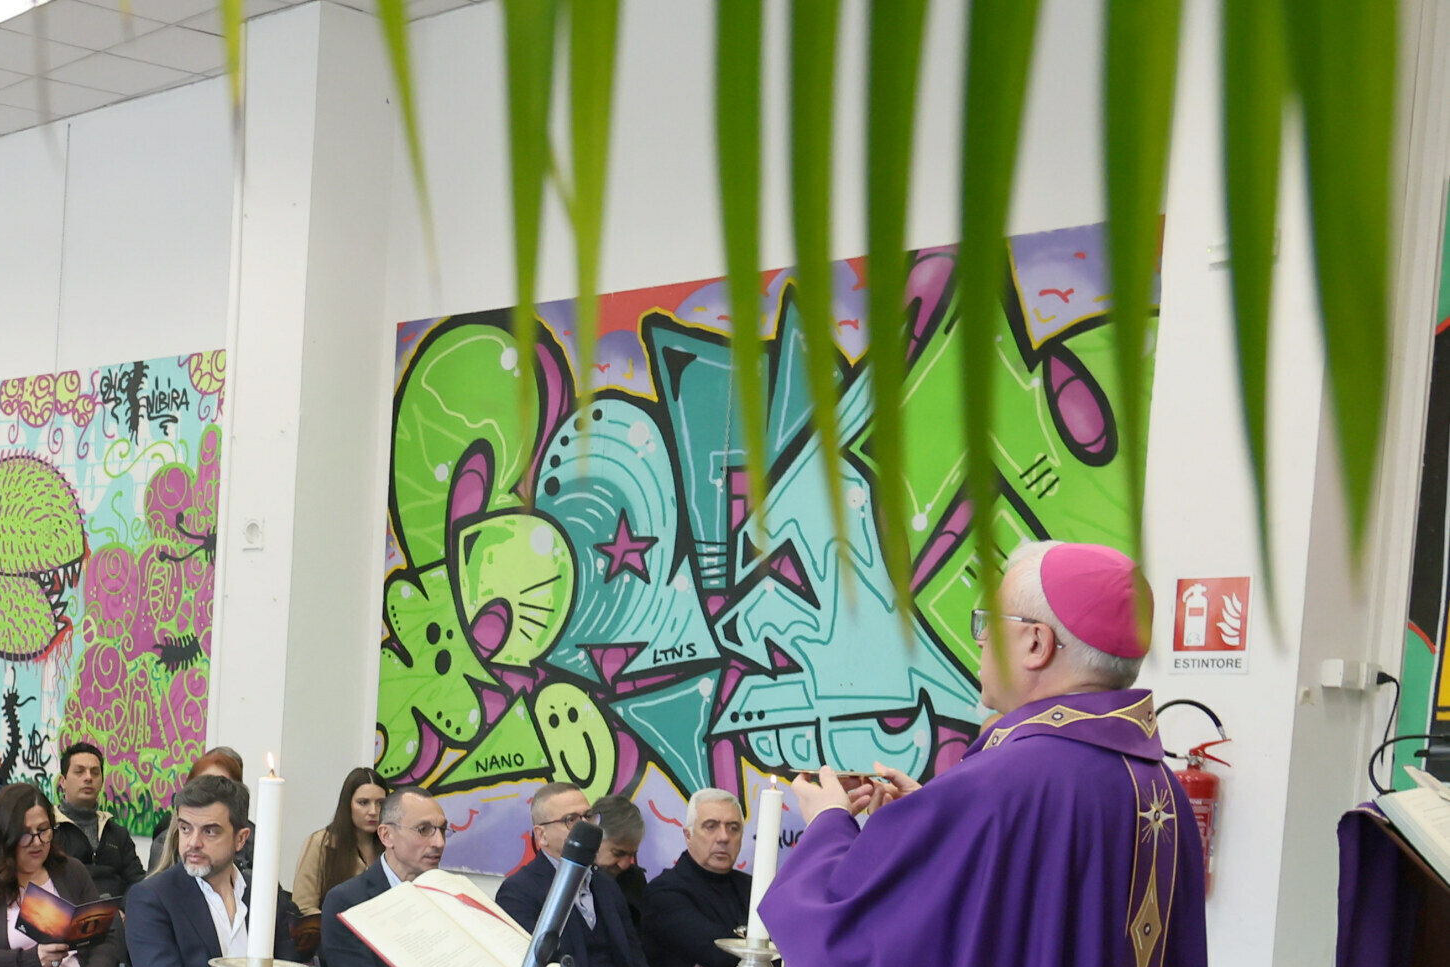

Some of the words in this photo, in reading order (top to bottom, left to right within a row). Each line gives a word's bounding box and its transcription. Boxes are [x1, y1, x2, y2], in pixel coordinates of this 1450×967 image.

[652, 642, 698, 665] LTNS
[1174, 658, 1242, 669] ESTINTORE
[475, 752, 525, 773] NANO
